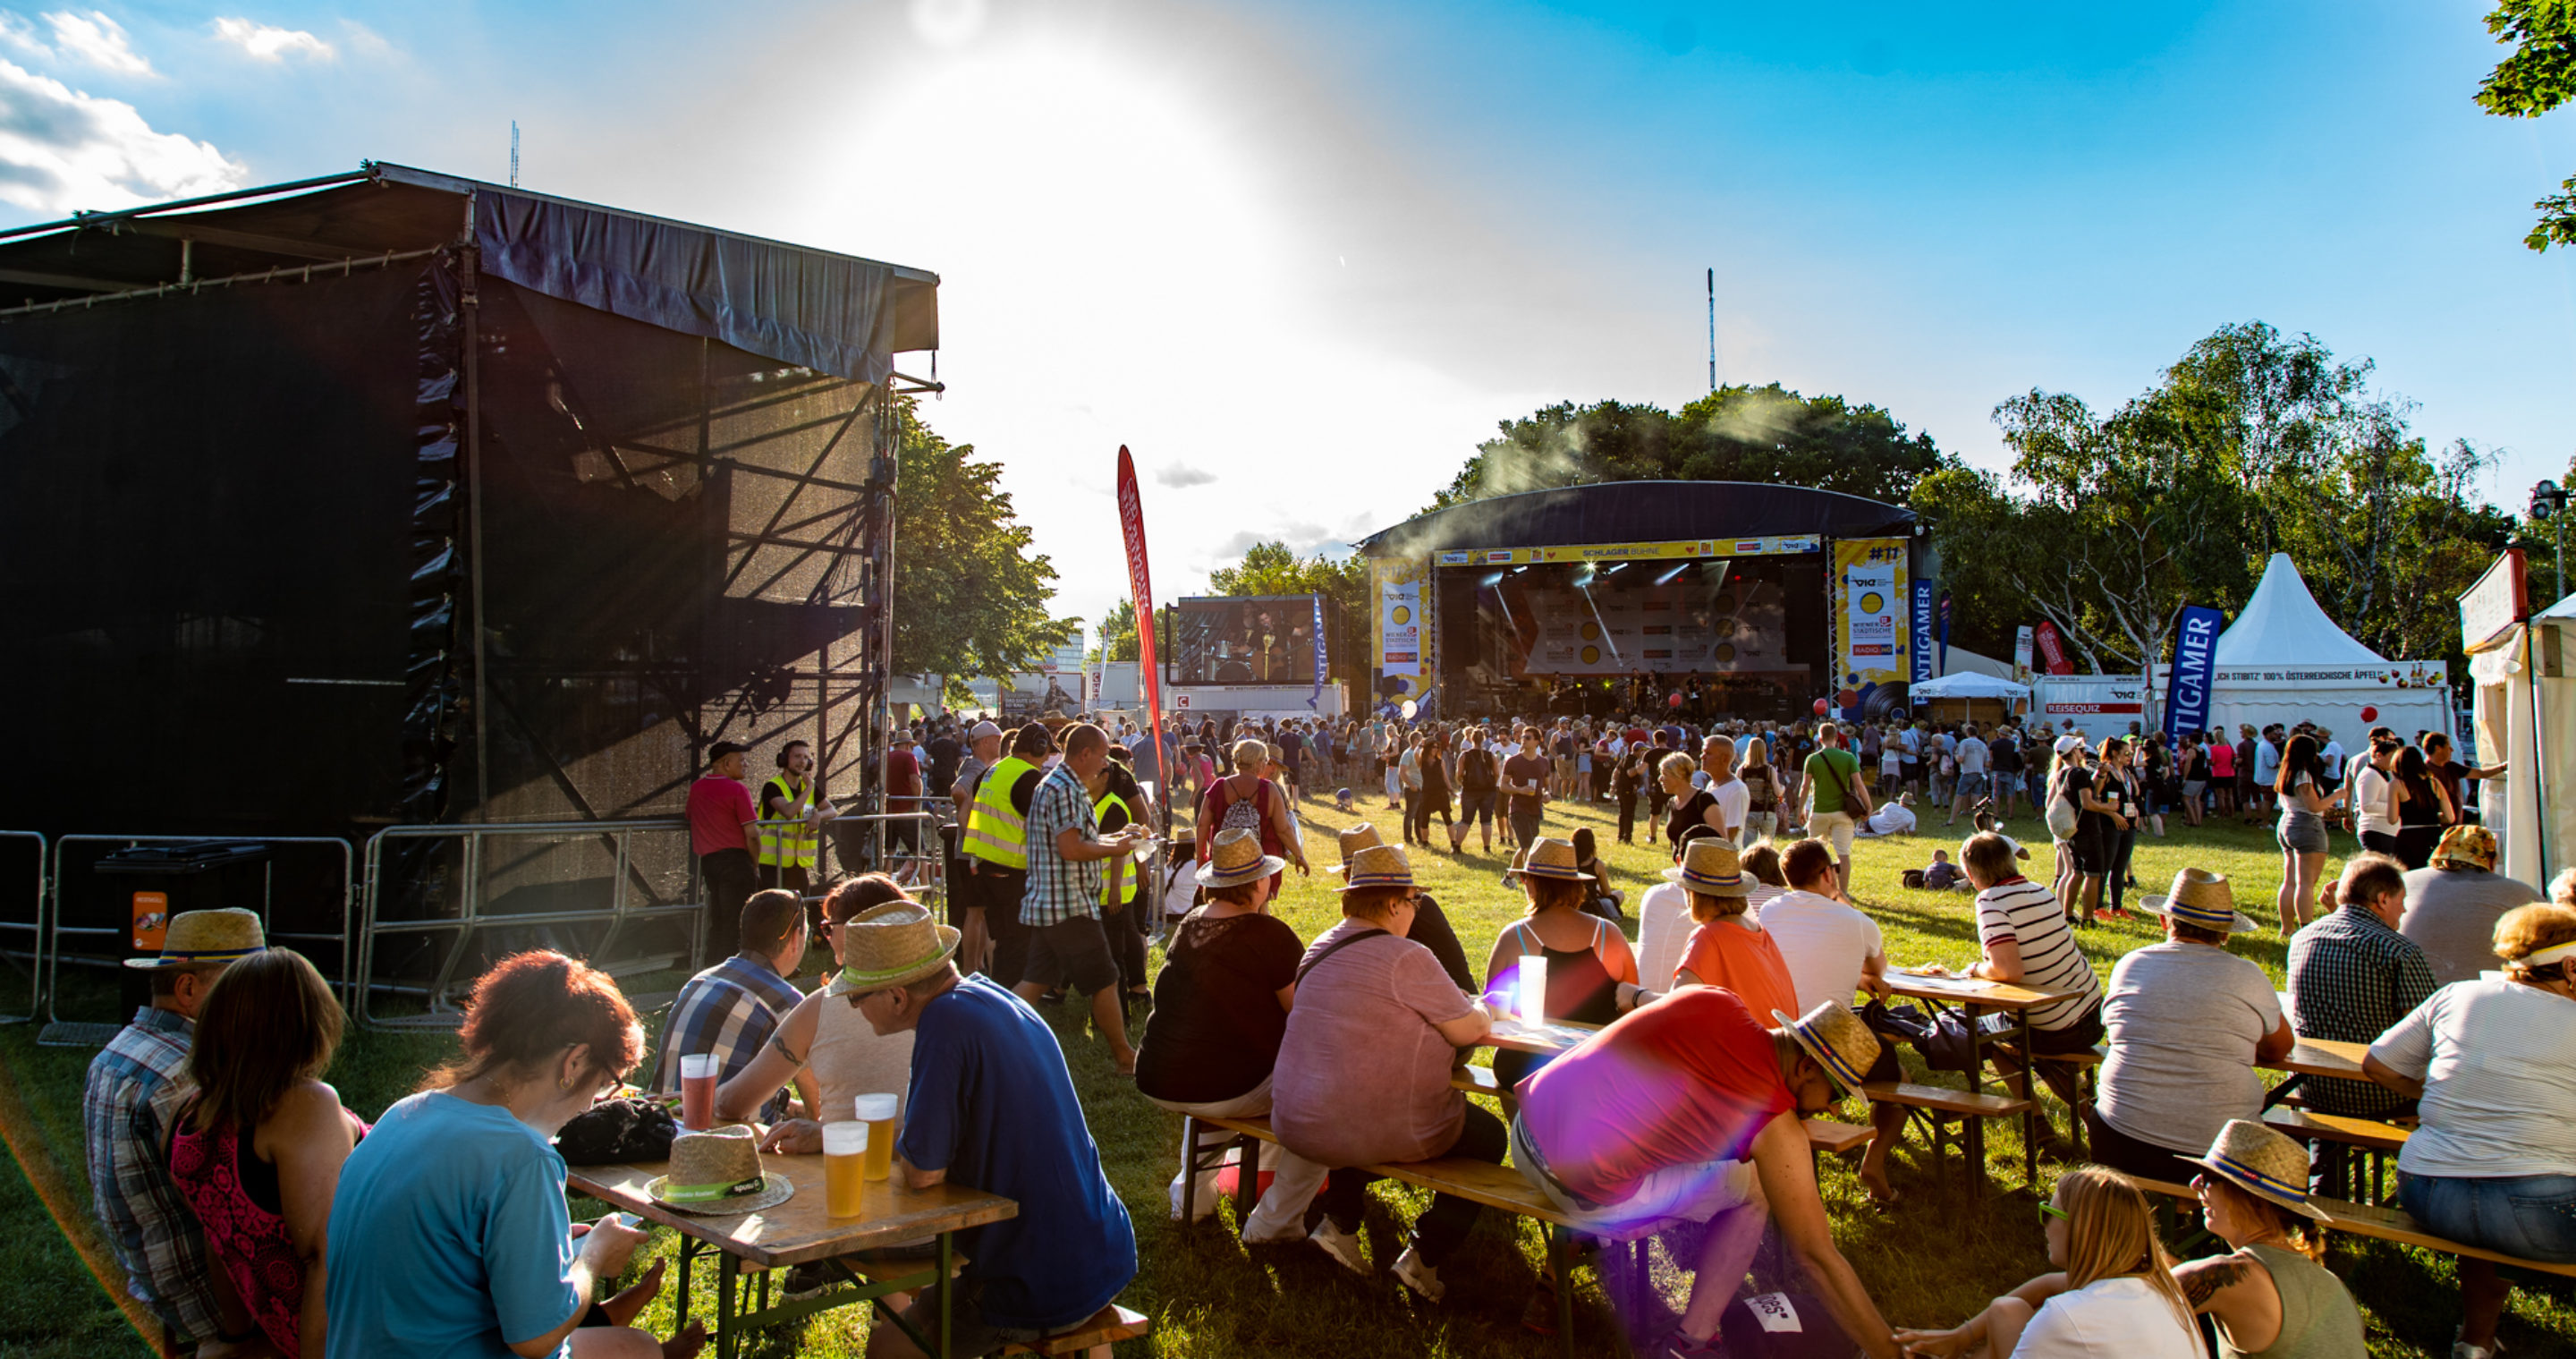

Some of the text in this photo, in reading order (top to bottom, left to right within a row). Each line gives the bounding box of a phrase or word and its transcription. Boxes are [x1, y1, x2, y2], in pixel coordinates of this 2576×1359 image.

[1582, 548, 1629, 556] SCHLAGER
[1868, 546, 1899, 560] #11
[1914, 587, 1930, 705] PNTIGAMER
[2286, 671, 2352, 680] ÖSTERREICHISCHE
[2172, 617, 2213, 757] TIGAMER
[2048, 704, 2101, 714] REISEQUIZ
